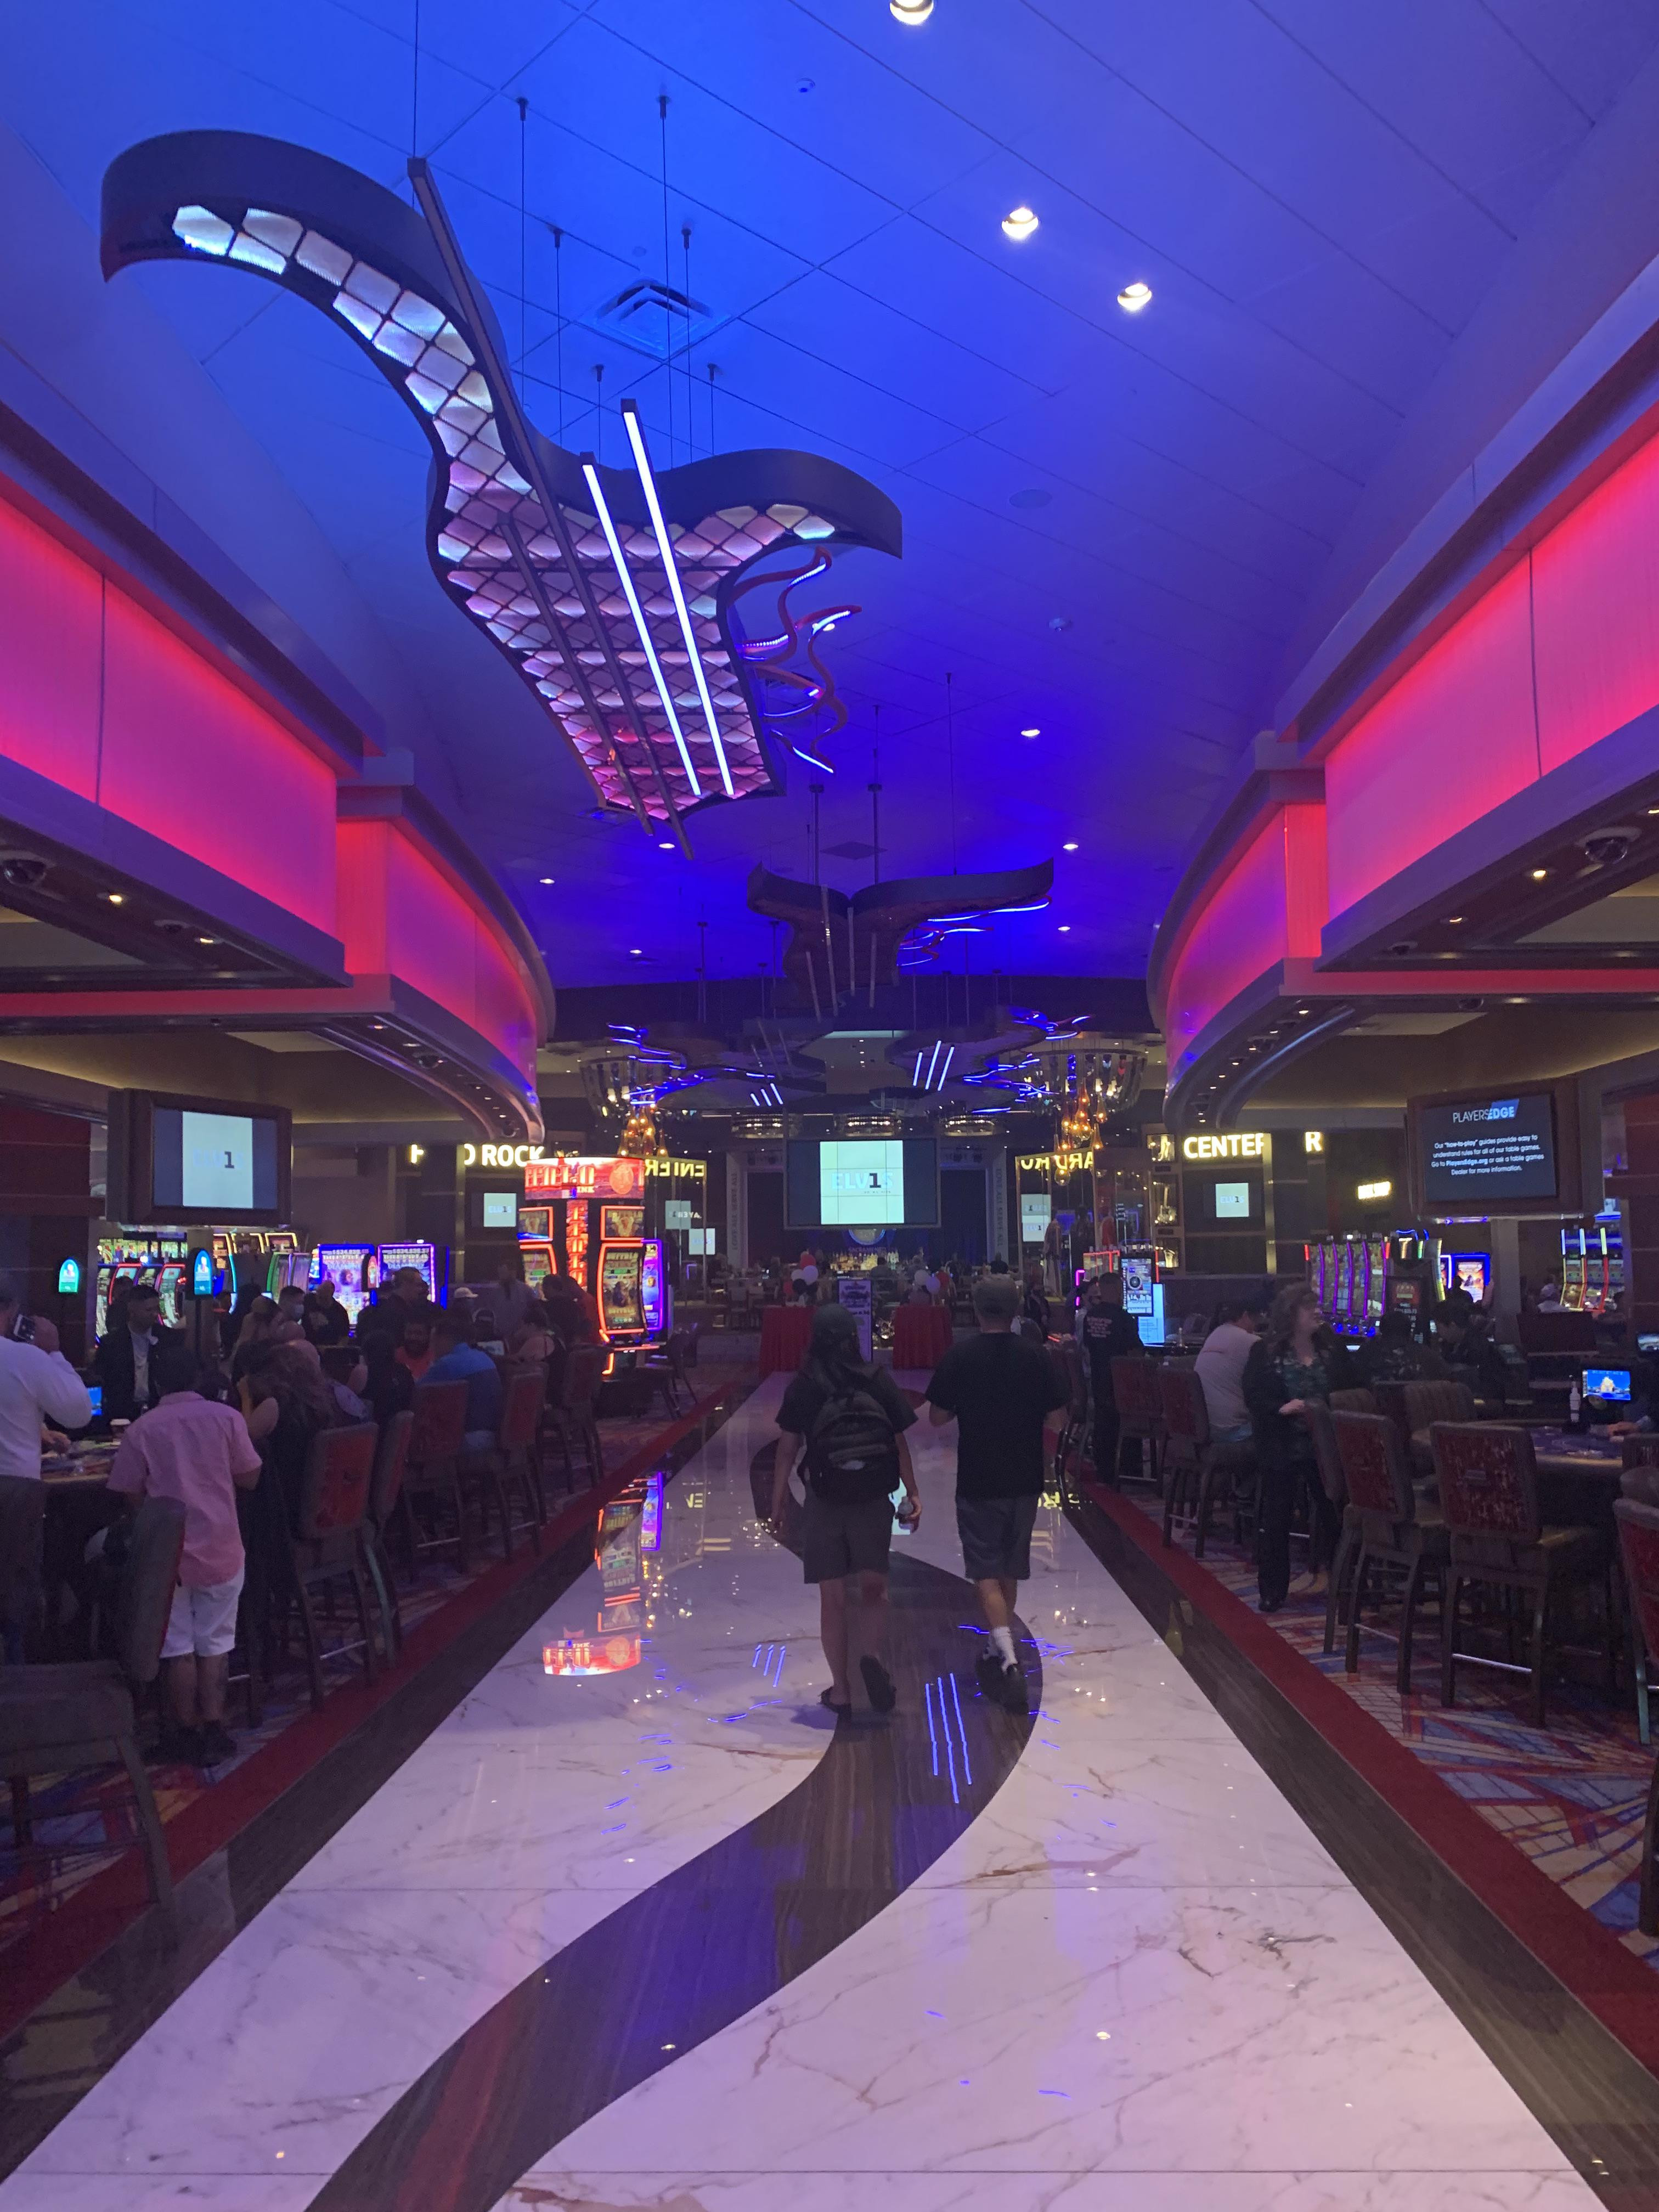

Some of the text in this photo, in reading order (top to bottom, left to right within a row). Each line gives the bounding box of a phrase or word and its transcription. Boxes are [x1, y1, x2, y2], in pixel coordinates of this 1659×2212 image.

[1497, 1136, 1517, 1144] provide
[482, 1144, 544, 1167] ROCK
[1432, 1150, 1461, 1158] understand
[1520, 1144, 1541, 1153] games.
